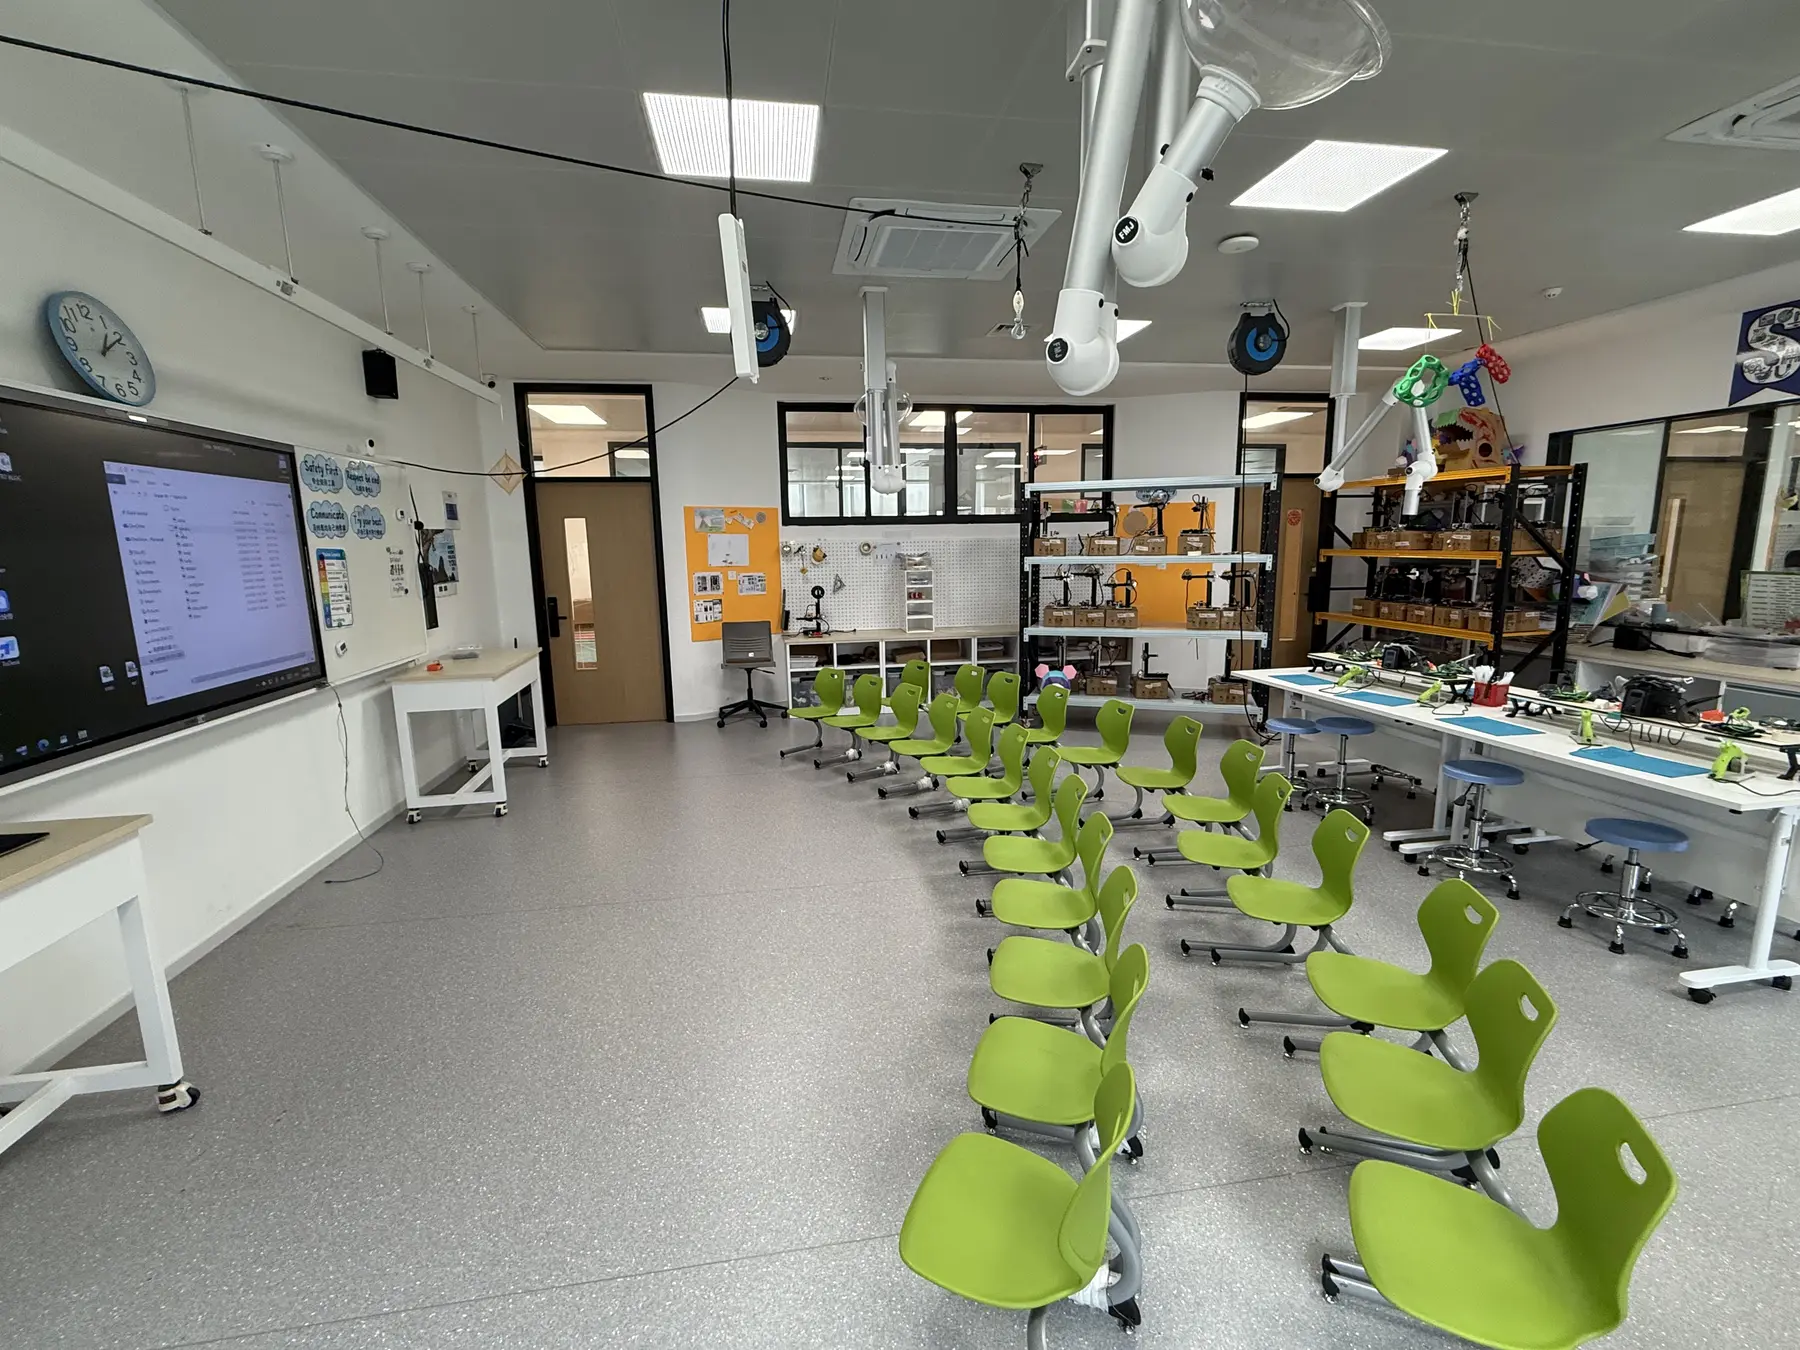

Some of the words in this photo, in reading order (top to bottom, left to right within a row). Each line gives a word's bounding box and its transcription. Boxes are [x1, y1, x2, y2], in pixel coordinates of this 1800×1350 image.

[1118, 221, 1135, 240] FMJ
[63, 305, 78, 322] 11
[76, 303, 94, 321] 12
[59, 316, 76, 334] 10
[99, 315, 108, 330] 1
[65, 336, 78, 352] 9
[113, 331, 126, 346] 2
[80, 357, 93, 373] 8
[126, 351, 138, 366] 3
[96, 374, 106, 388] 7
[132, 369, 142, 383] 4
[115, 383, 127, 398] 6
[127, 381, 139, 396] 5
[304, 460, 324, 478] Safety
[325, 463, 339, 476] First
[310, 507, 345, 520] Communicate
